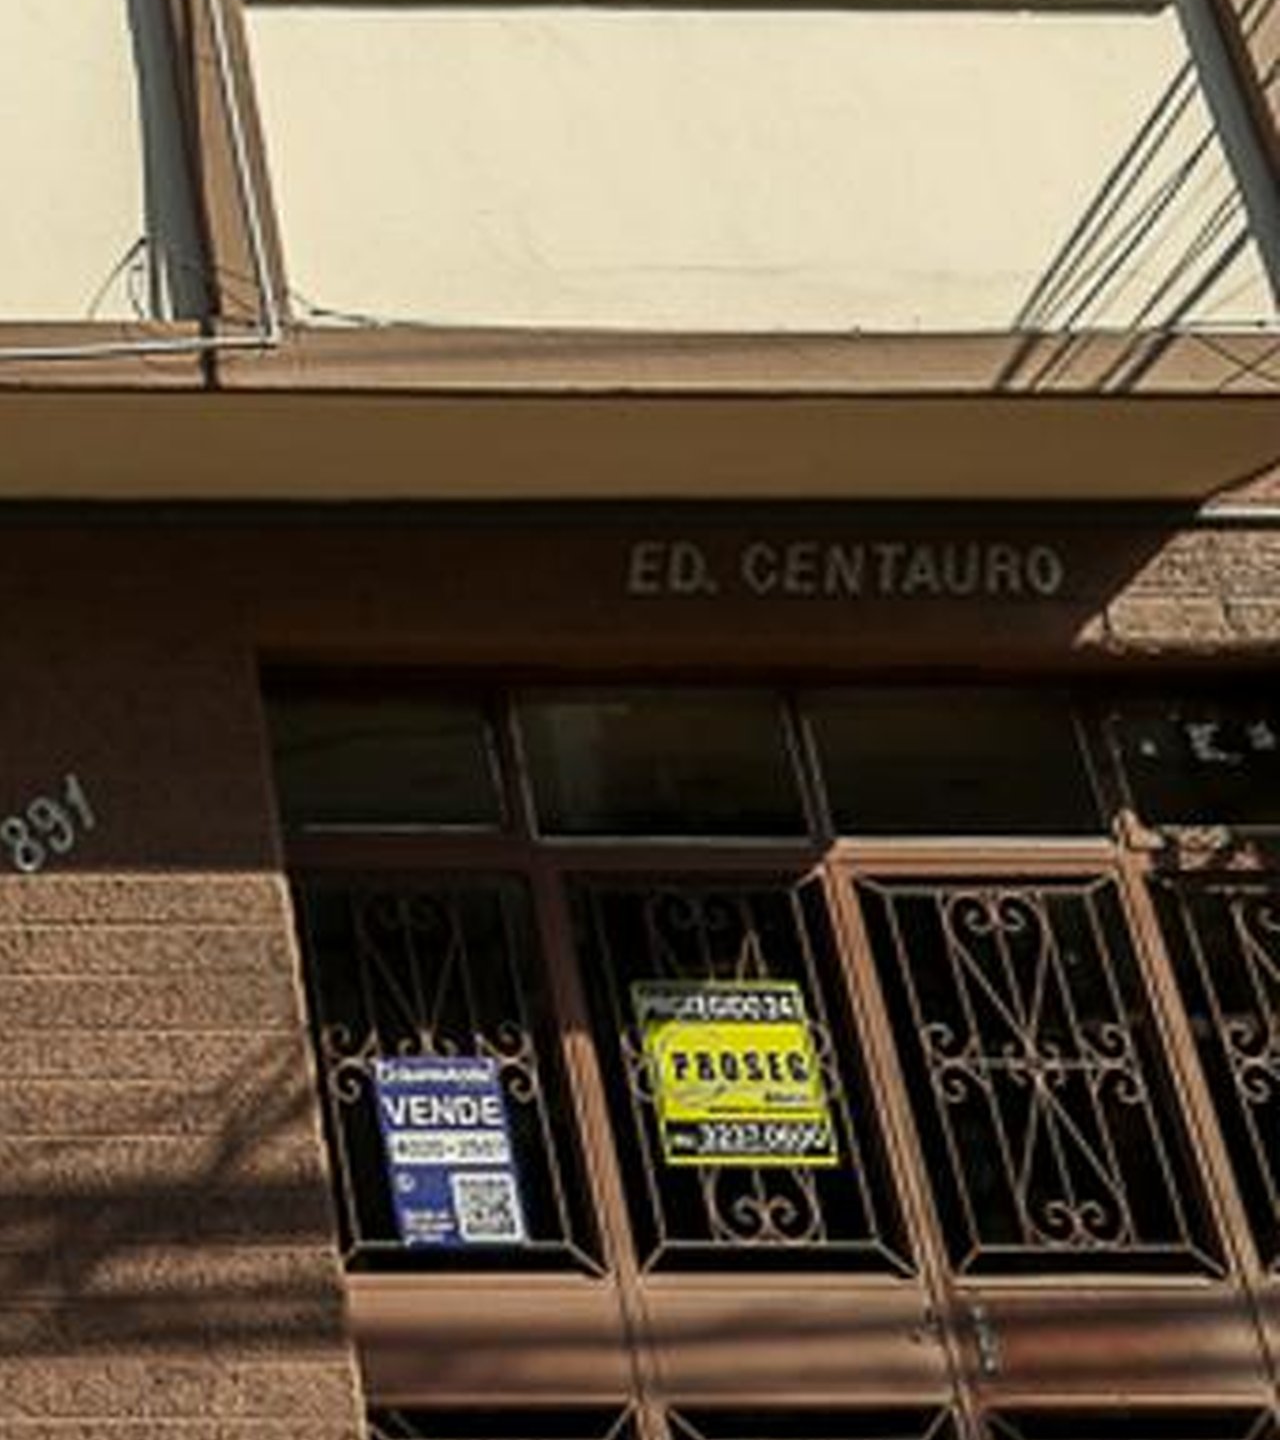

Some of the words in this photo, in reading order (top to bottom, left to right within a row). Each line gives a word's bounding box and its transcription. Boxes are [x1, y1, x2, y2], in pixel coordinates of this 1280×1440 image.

[628, 542, 718, 595] ED.
[743, 541, 1065, 596] CENTAURO
[0, 772, 96, 873] 891
[670, 1050, 811, 1082] PROSEG
[382, 1095, 505, 1126] VENDE
